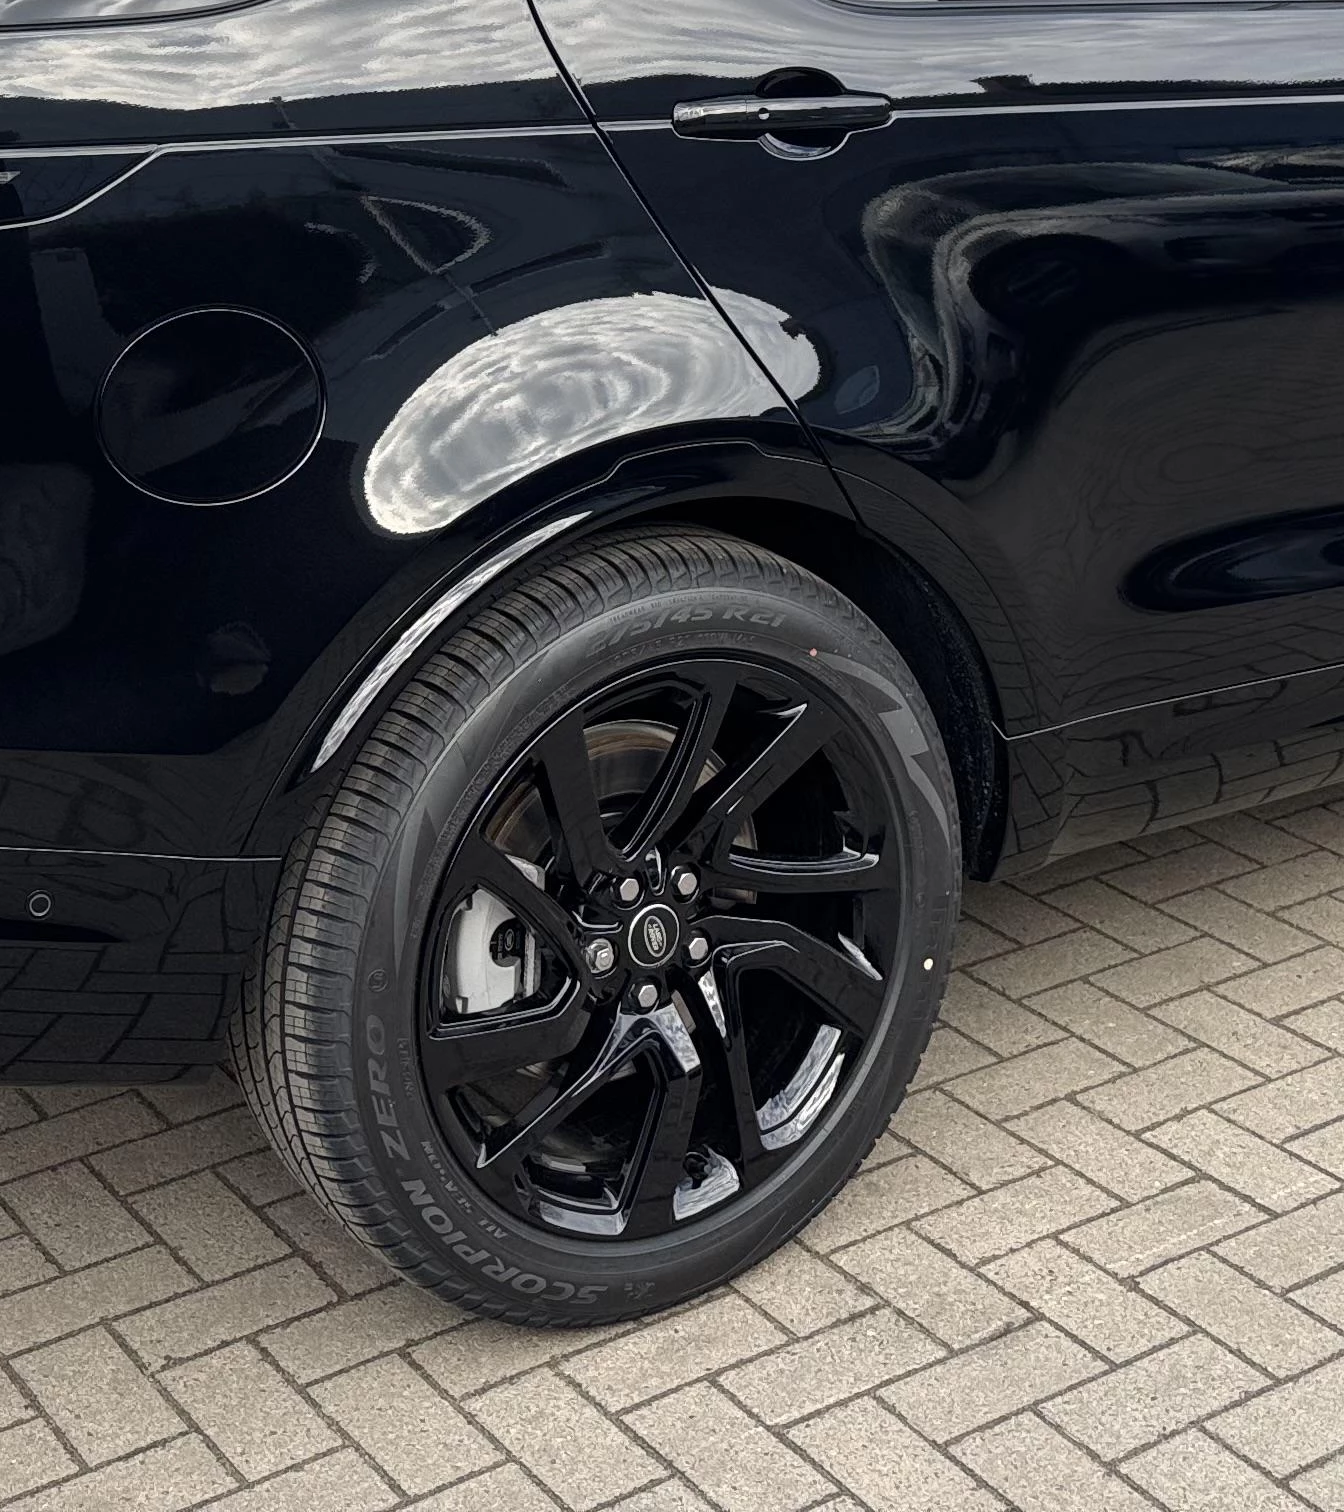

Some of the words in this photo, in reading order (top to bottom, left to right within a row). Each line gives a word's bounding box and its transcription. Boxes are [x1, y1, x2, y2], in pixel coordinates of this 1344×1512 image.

[722, 604, 787, 628] R21
[365, 1014, 411, 1161] ZERO
[401, 1178, 609, 1304] SCORPION
